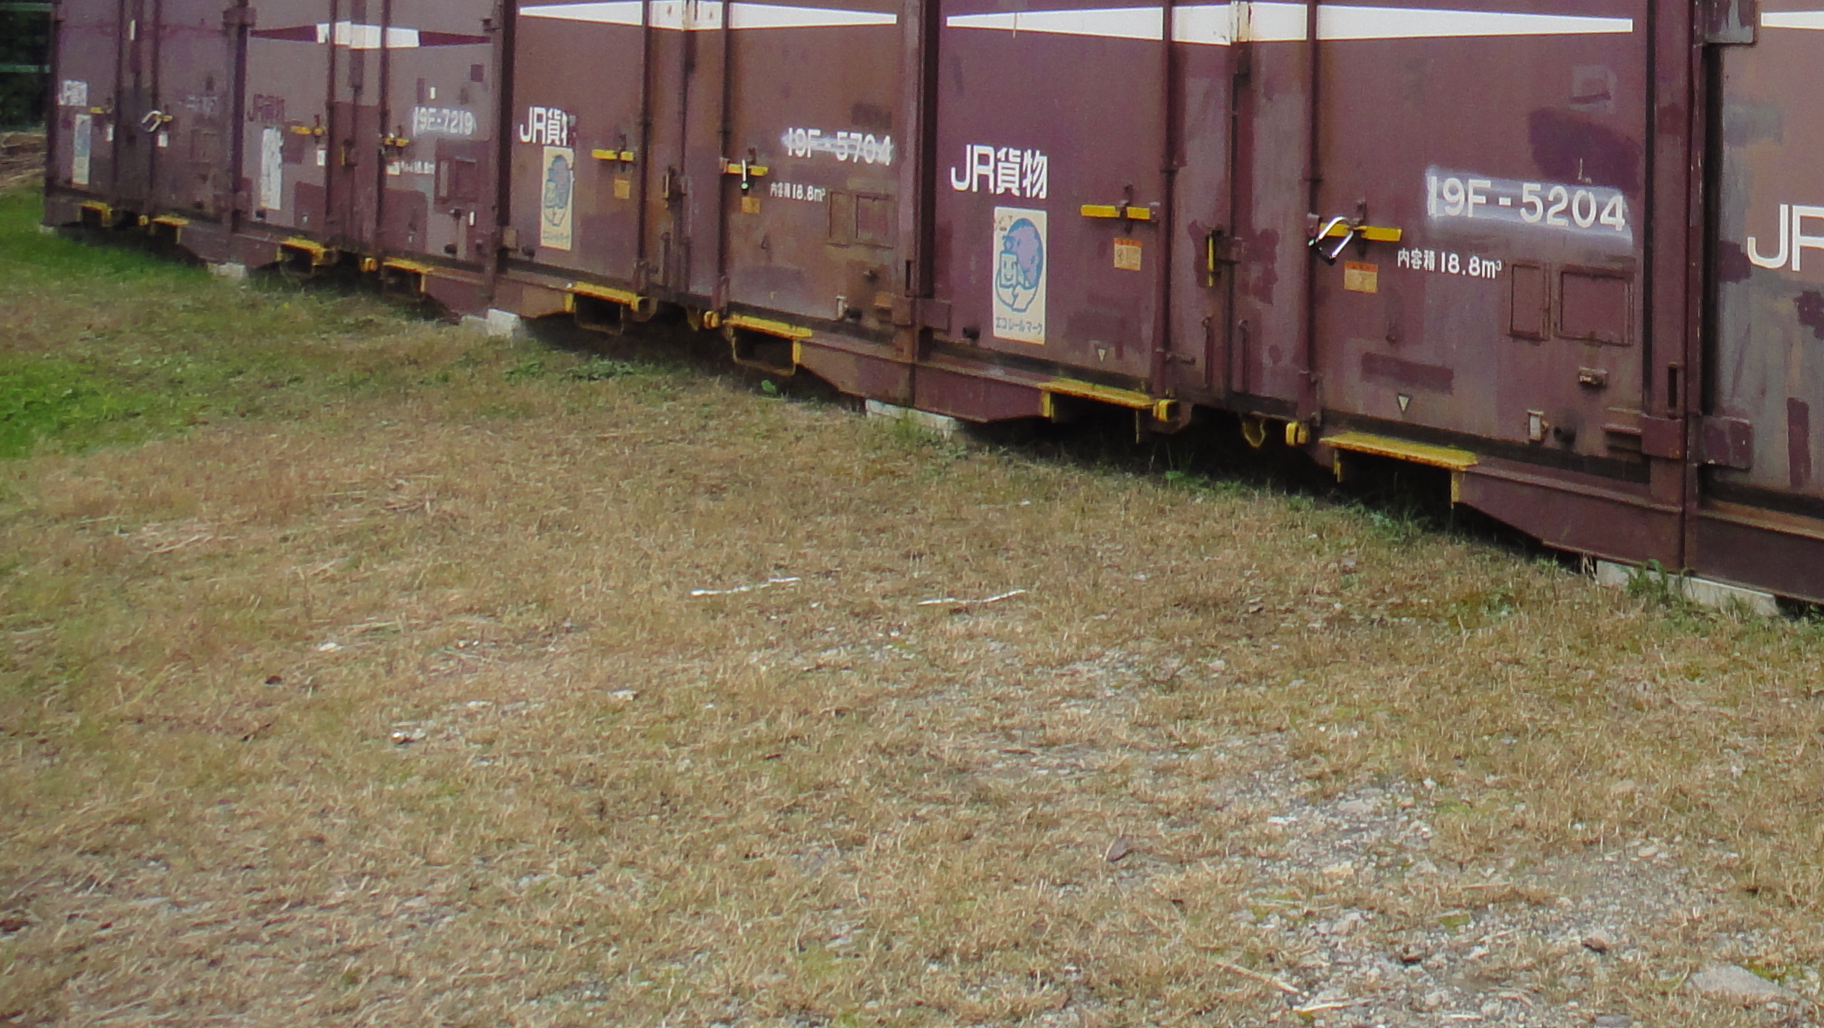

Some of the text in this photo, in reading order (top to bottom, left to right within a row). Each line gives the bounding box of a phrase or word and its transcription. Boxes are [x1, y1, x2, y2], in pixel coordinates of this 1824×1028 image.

[788, 127, 892, 166] 19F-5704
[950, 144, 1048, 199] JR貨物
[1428, 175, 1626, 231] 19F-5204
[1397, 247, 1436, 272] 内容積
[995, 316, 1043, 335] エコレールマーク
